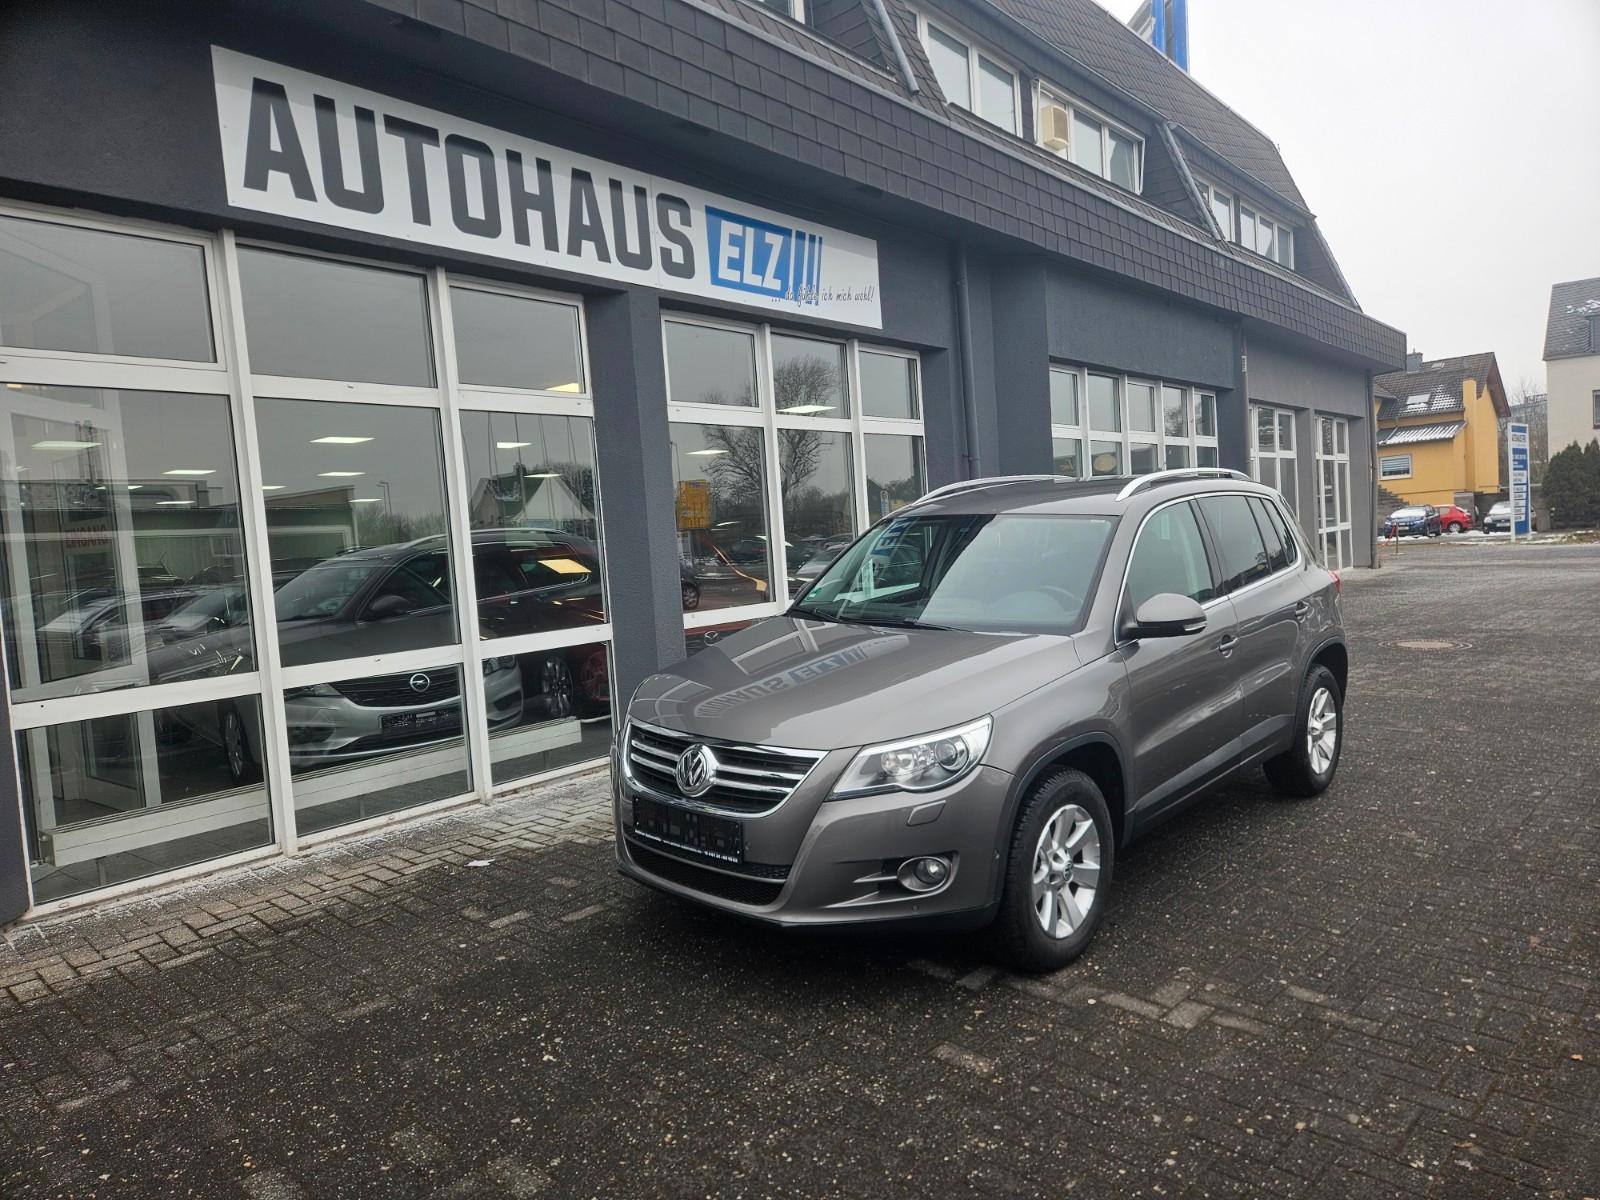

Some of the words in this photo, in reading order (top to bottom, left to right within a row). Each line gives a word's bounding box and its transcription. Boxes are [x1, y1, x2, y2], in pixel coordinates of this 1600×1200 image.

[243, 77, 696, 279] AUTOHAUS
[718, 219, 784, 291] ELZ
[821, 285, 833, 302] ich
[835, 285, 852, 302] mich
[854, 284, 875, 303] wohl!
